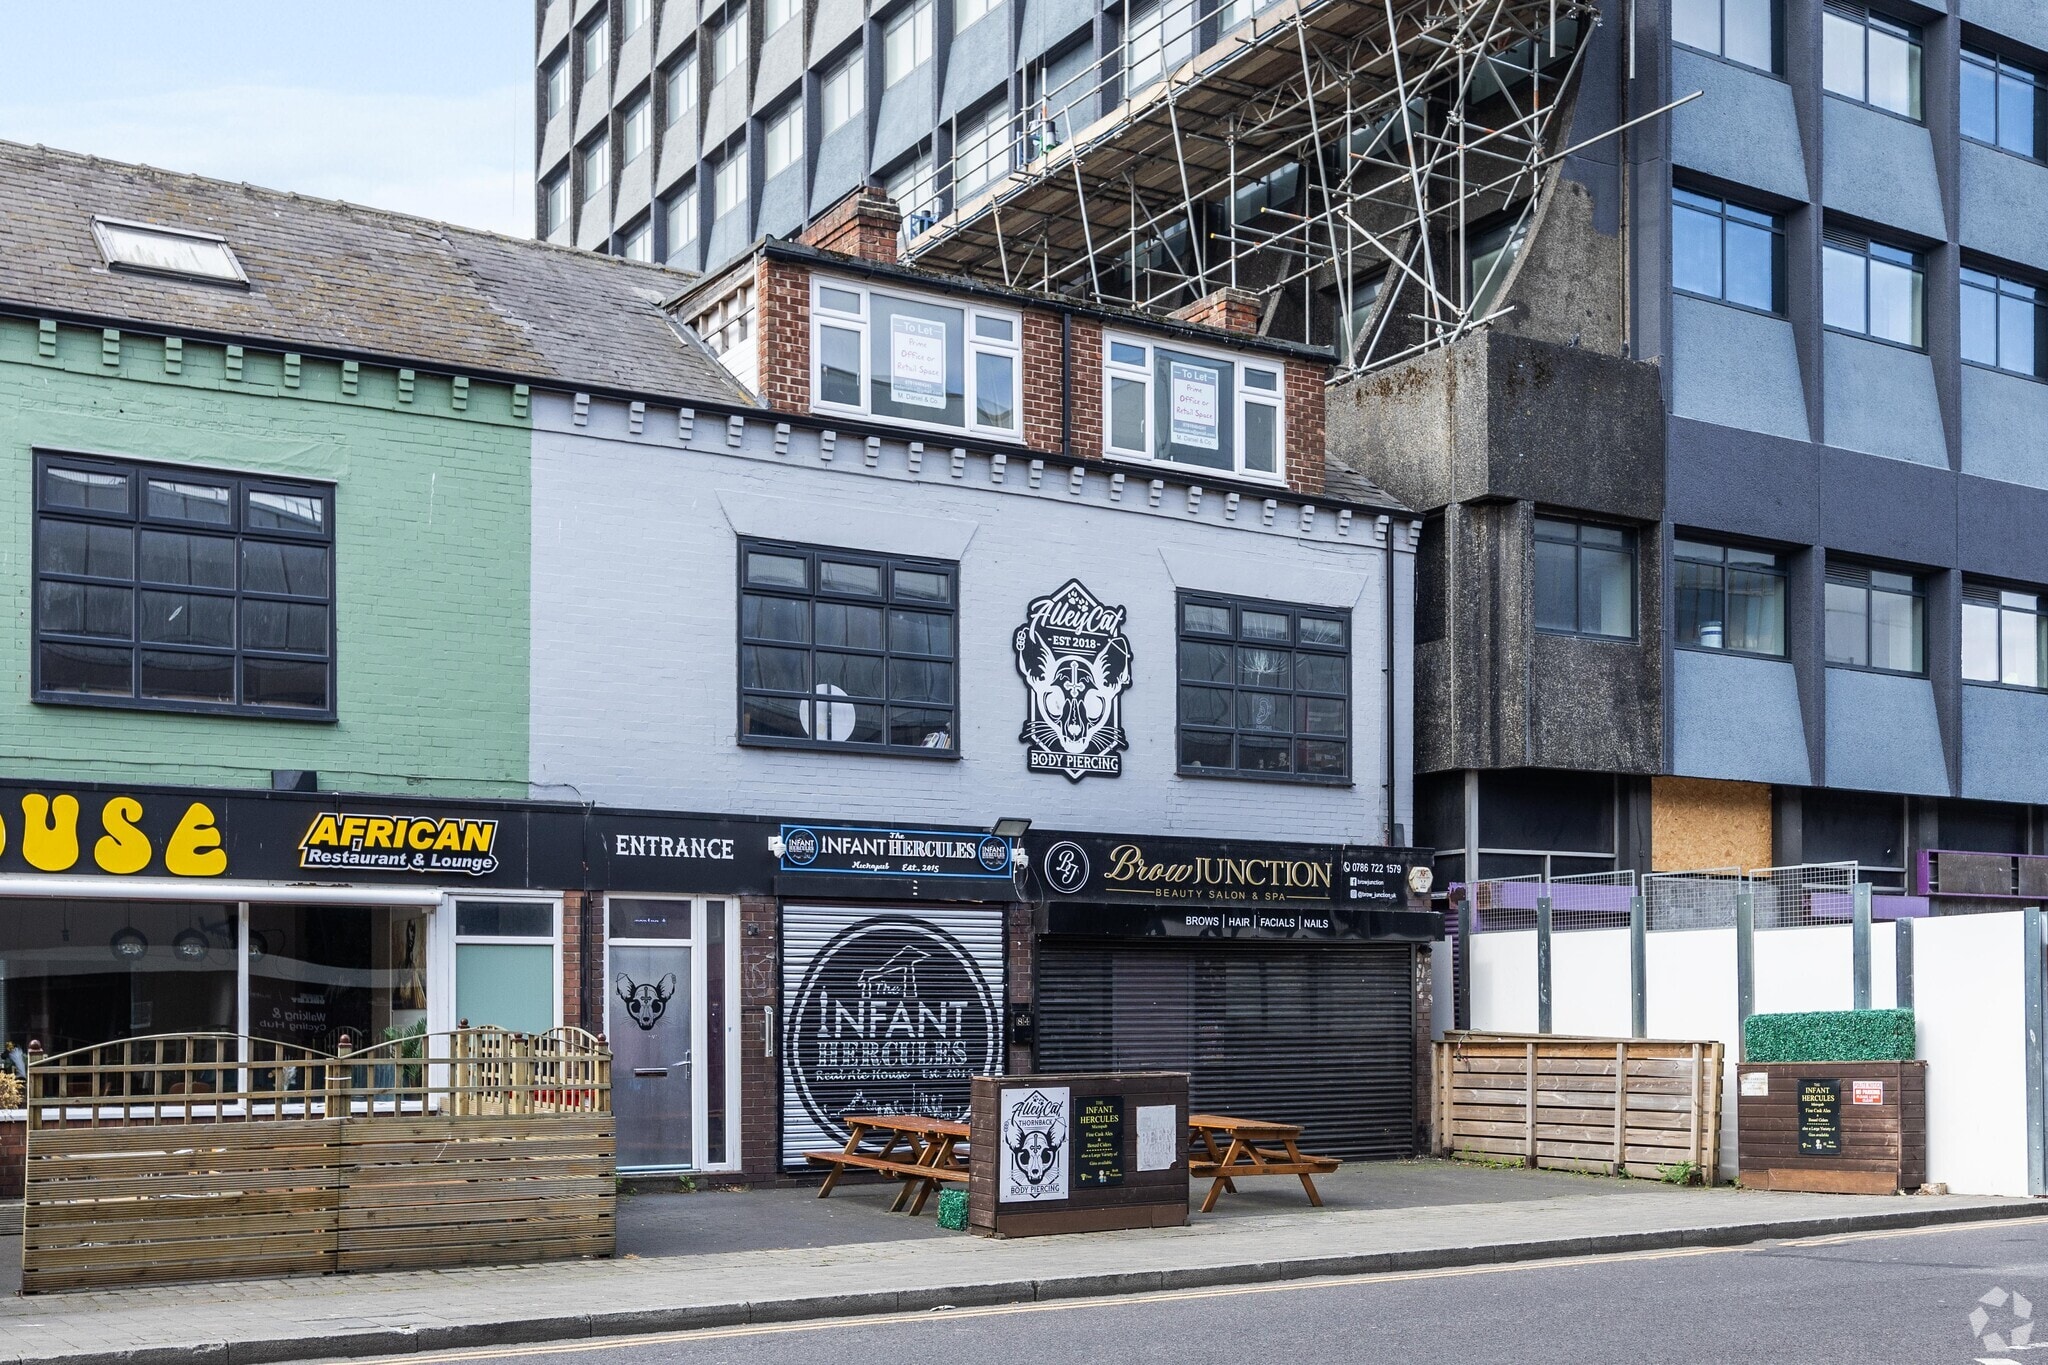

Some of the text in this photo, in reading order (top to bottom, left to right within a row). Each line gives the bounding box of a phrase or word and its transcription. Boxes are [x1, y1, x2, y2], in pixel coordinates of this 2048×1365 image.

[904, 322, 933, 336] To Let
[909, 338, 927, 348] Prime
[901, 350, 924, 361] Office
[897, 362, 940, 376] Retail Space
[1182, 369, 1208, 382] To Let
[1186, 384, 1202, 393] Prime
[1180, 395, 1200, 406] Office
[1176, 407, 1213, 419] Retail Space
[1052, 636, 1096, 649] EST 2018
[1031, 754, 1119, 770] BODY PIERCING
[0, 793, 228, 876] USE
[308, 816, 494, 852] AFRICAN
[616, 834, 734, 860] ENTRANCE
[820, 835, 976, 859] INFANT HERCULES
[308, 849, 493, 871] Restaurant & Lounge
[1104, 844, 1332, 888] Brow JUNCTION
[922, 864, 940, 873] 2015
[1352, 862, 1402, 874] 0786 722 1579
[1155, 888, 1286, 901] BEAUTY SALON & SPA
[1185, 916, 1329, 929] BROWS HAIR FACIALS NAILS
[875, 982, 901, 996] The
[816, 985, 969, 1039] INFANT
[1017, 1017, 1030, 1026] 84
[816, 1041, 968, 1067] HERCULES
[816, 1068, 846, 1081] Real
[871, 1068, 911, 1080] House
[922, 1068, 943, 1079] Est.
[946, 1068, 974, 1079] 2015
[1085, 1106, 1114, 1114] INFANT
[1080, 1115, 1119, 1124] HERCULES
[1011, 1184, 1060, 1194] BODY PIERCING
